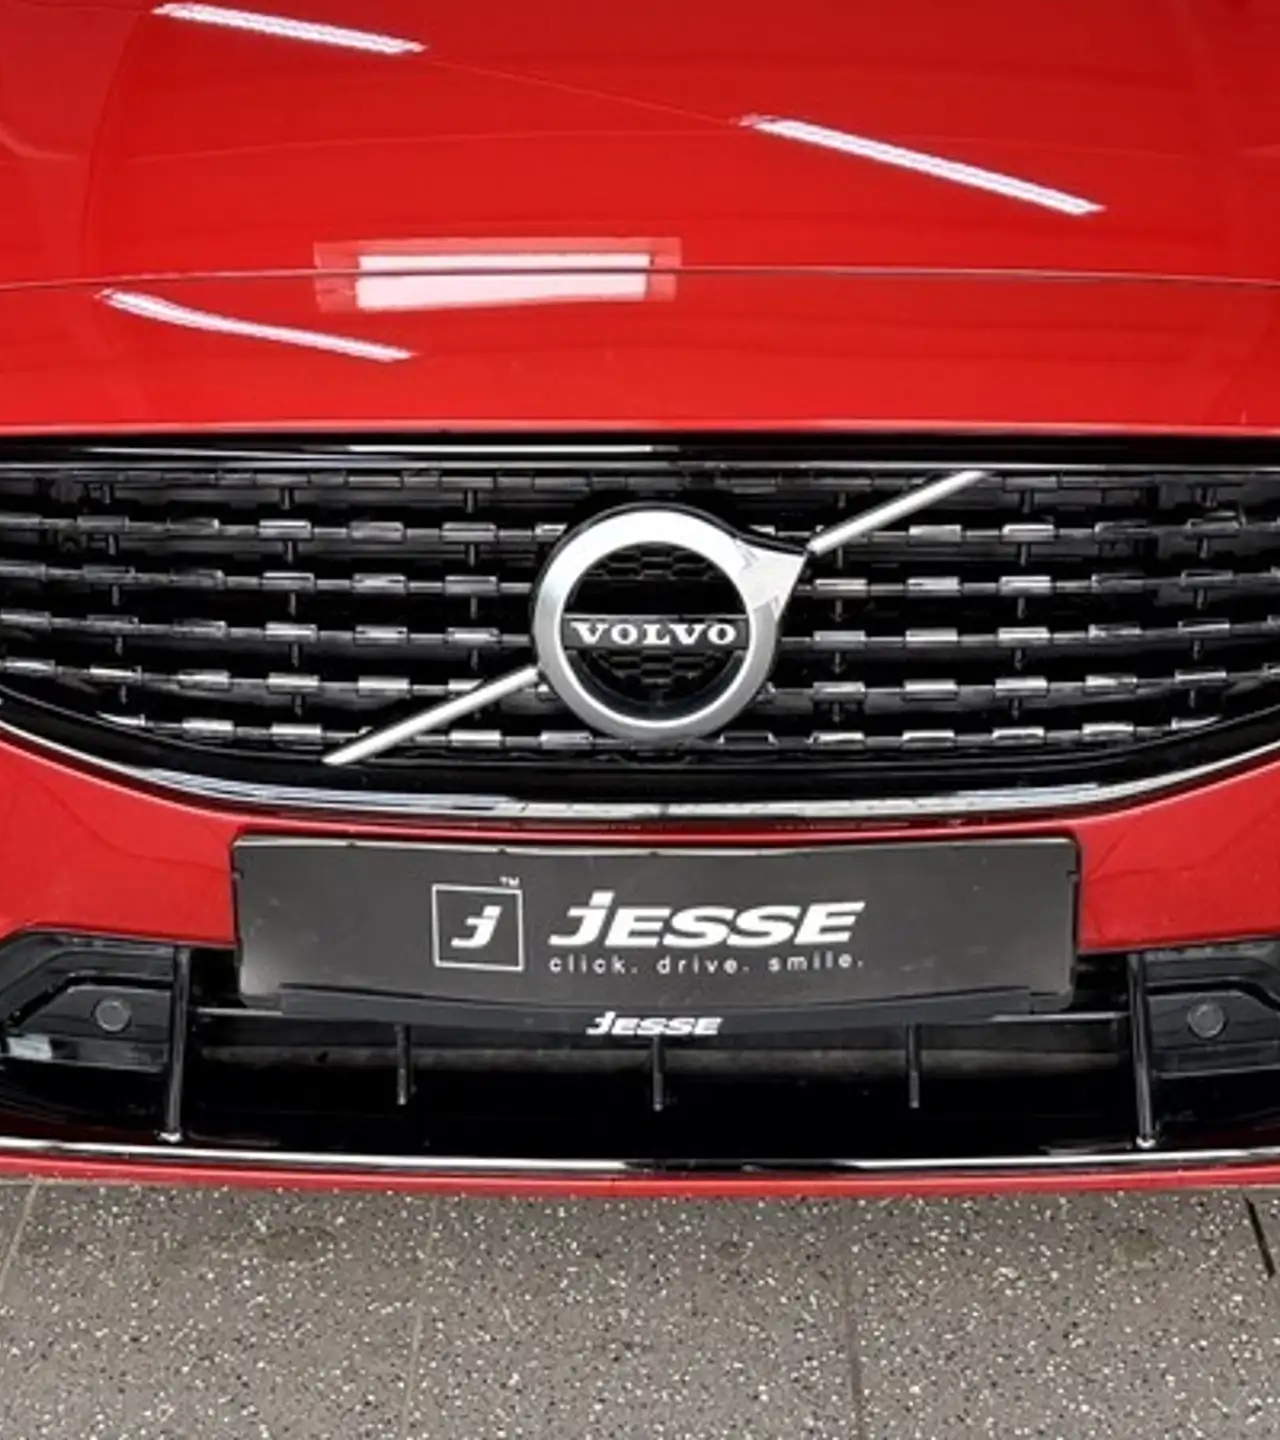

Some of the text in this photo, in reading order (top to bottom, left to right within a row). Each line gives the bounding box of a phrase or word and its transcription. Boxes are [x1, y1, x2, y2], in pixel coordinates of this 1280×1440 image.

[571, 623, 737, 645] VOLVO
[549, 951, 864, 974] click. drive. smile.
